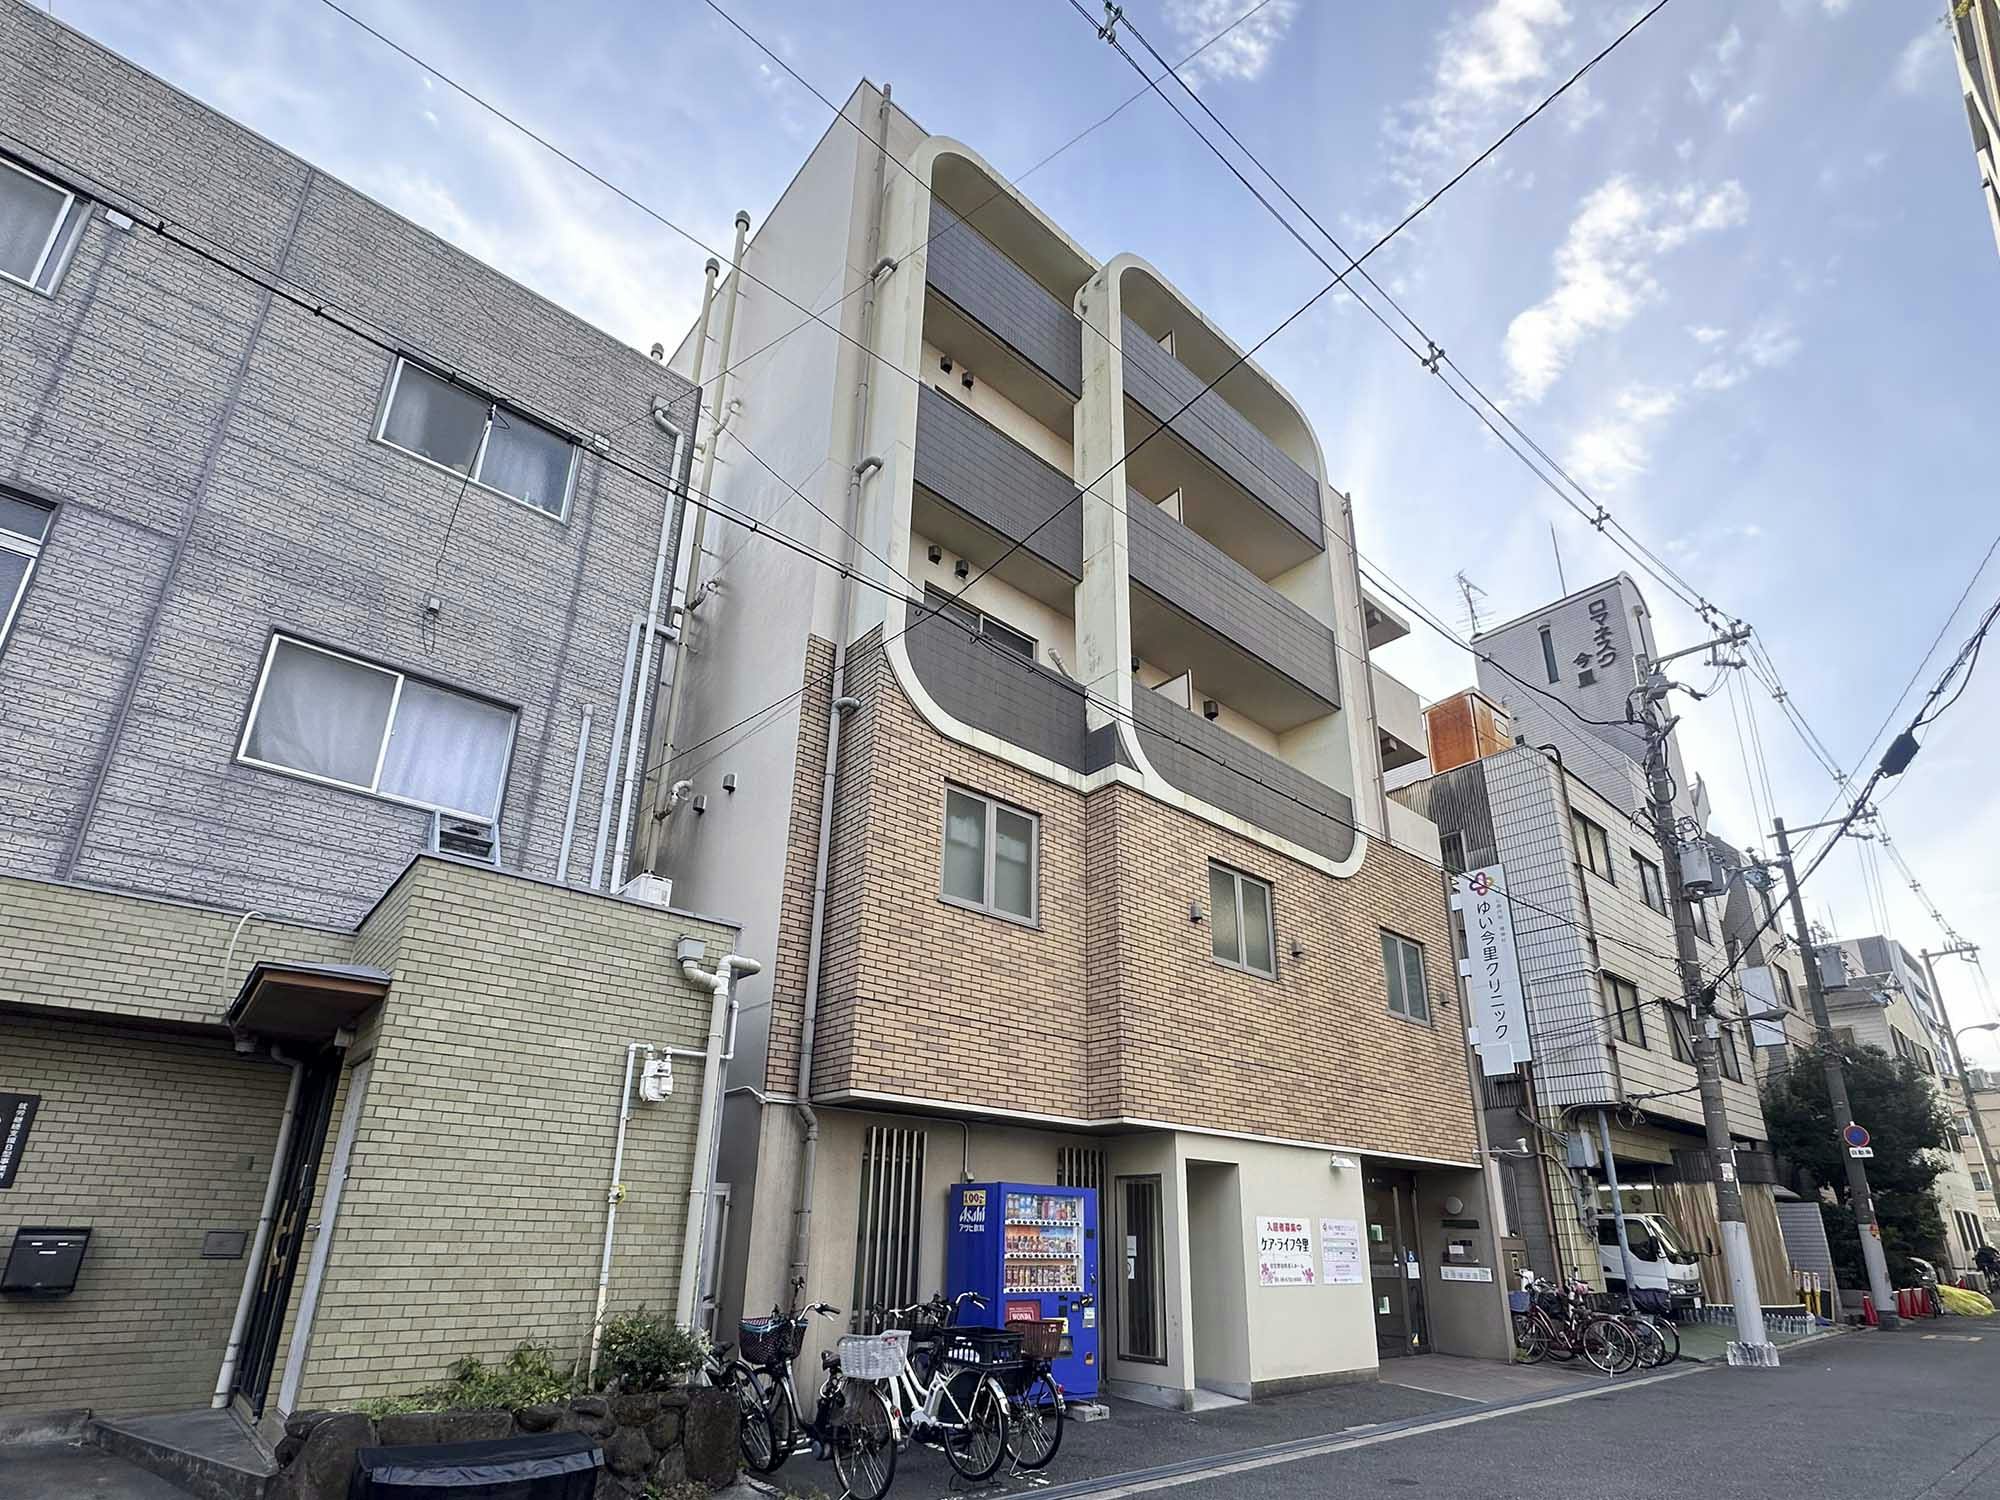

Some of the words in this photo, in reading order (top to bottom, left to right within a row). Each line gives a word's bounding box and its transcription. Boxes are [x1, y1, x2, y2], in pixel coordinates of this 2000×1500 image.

[1476, 900, 1509, 1040] ゆい今里クリニック
[959, 1206, 986, 1223] Asahi
[1261, 1235, 1310, 1252] ケア・ライフ今里
